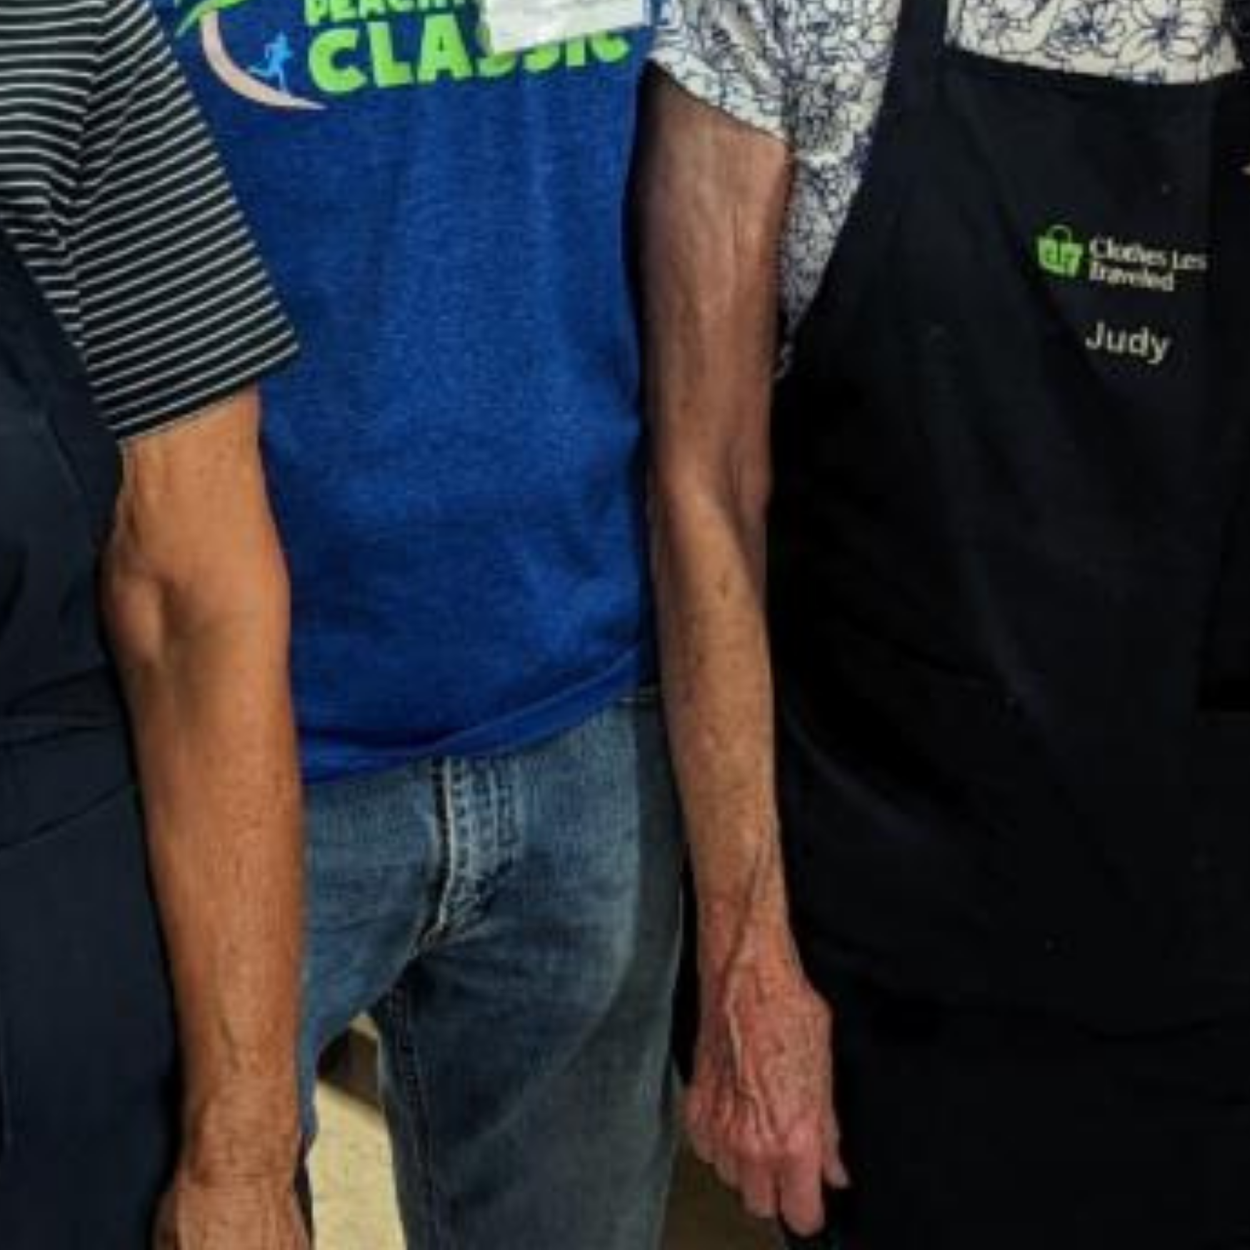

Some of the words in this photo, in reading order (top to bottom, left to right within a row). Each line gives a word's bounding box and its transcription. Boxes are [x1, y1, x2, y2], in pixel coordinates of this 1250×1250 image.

[308, 13, 630, 93] CLAC
[1089, 234, 1166, 267] Clothes
[1172, 249, 1207, 271] Les
[1089, 259, 1175, 292] Traveled
[1085, 321, 1172, 364] Judy
